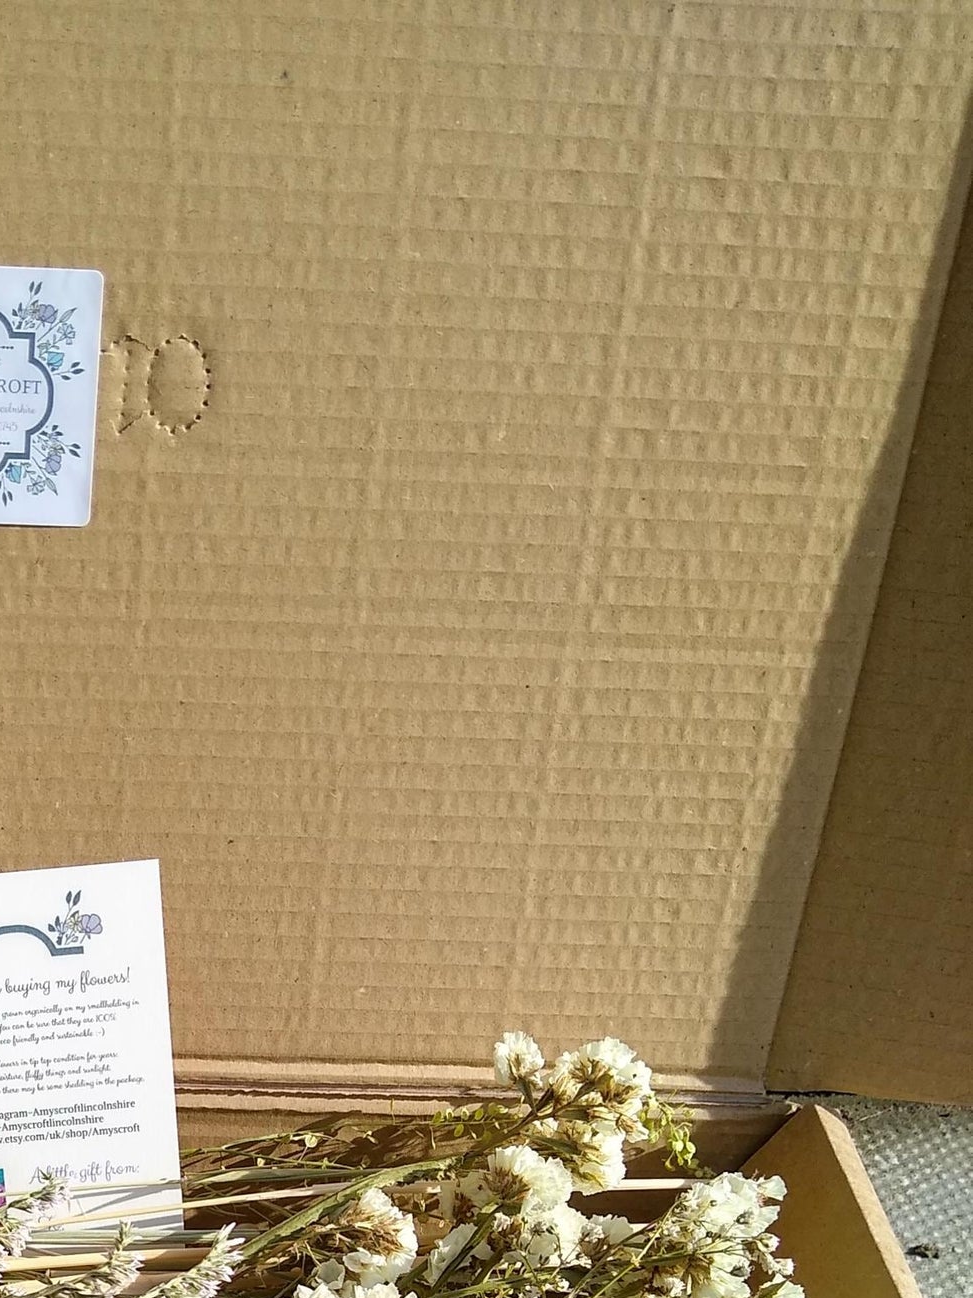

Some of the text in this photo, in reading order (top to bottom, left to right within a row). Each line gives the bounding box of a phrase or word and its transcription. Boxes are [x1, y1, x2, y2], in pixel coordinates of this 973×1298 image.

[4, 978, 51, 998] buying
[56, 978, 77, 994] my
[80, 967, 130, 993] flowers!
[2, 1011, 23, 1020] grown
[25, 1004, 63, 1017] organically
[75, 1005, 86, 1013] my
[87, 999, 131, 1010] smallholding
[26, 1021, 34, 1029] be
[51, 1017, 66, 1027] that
[66, 1016, 81, 1027] they
[95, 1013, 117, 1023] 100%
[12, 1033, 39, 1046] friendly
[41, 1032, 55, 1041] and
[56, 1028, 93, 1039] sustainable
[20, 1058, 29, 1066] in
[29, 1058, 39, 1068] tip
[40, 1057, 52, 1067] top
[53, 1053, 85, 1063] condition
[86, 1051, 97, 1062] for
[25, 1069, 44, 1081] fluffy
[45, 1069, 66, 1078] things
[67, 1066, 81, 1075] and
[2, 1086, 20, 1094] there
[37, 1083, 45, 1091] be
[65, 1079, 94, 1089] shedding
[104, 1077, 115, 1085] the
[28, 1166, 45, 1184] A
[79, 1161, 102, 1183] gift
[105, 1160, 140, 1182] from:
